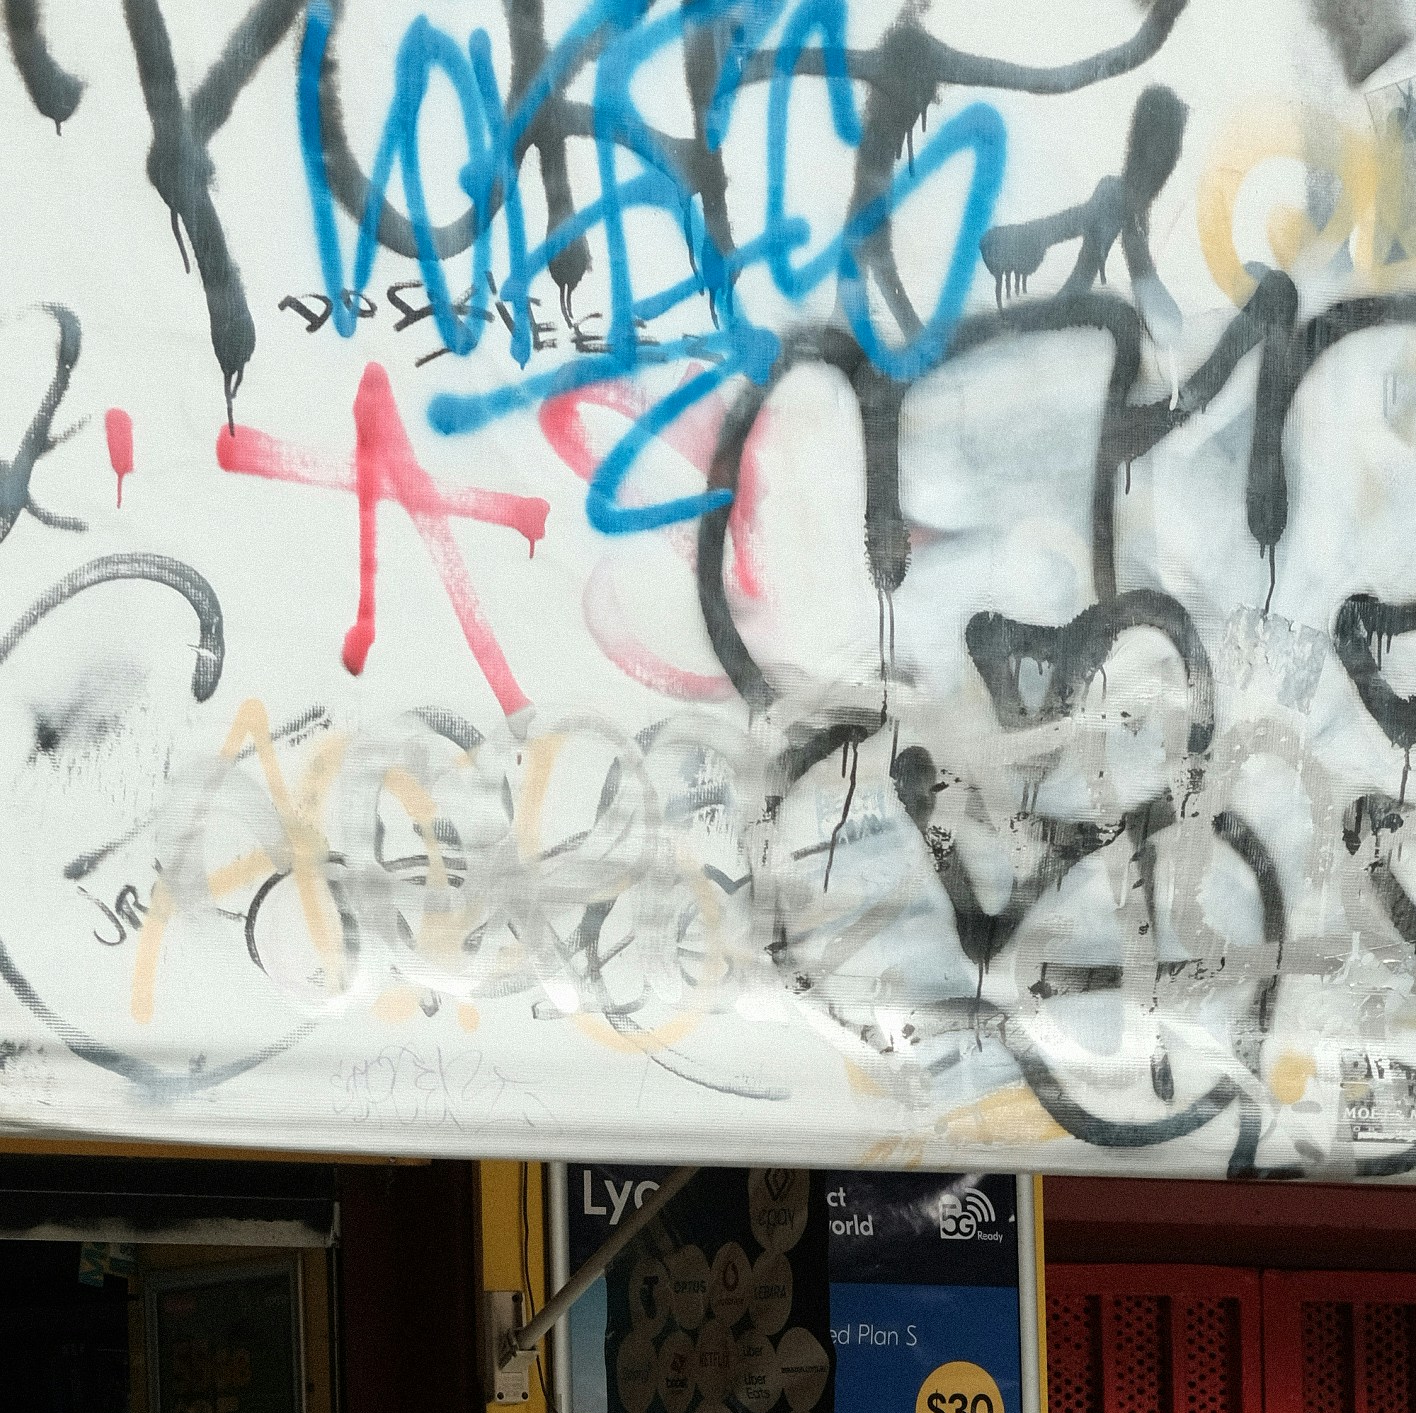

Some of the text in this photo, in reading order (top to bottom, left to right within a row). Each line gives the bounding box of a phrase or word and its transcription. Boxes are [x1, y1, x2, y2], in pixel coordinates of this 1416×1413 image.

[828, 1214, 875, 1237] orld
[977, 1230, 1003, 1243] Ready
[858, 1324, 899, 1346] Plan
[906, 1324, 918, 1346] S
